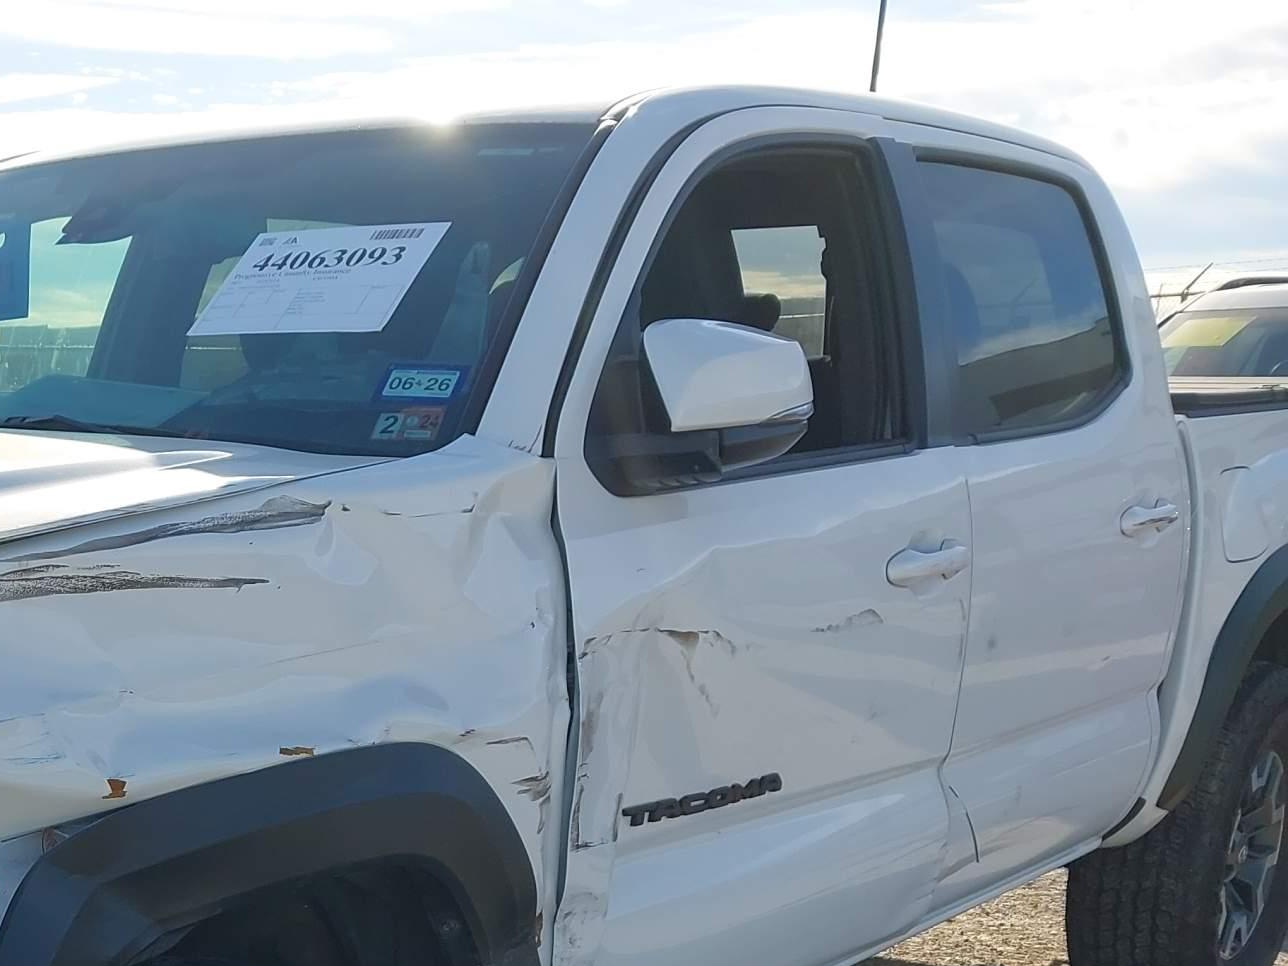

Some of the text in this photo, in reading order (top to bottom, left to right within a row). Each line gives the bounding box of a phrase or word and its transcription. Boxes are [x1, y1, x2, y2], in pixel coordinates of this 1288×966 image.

[252, 246, 407, 272] 44063093
[378, 414, 399, 434] 2
[621, 772, 783, 827] TACOMA
